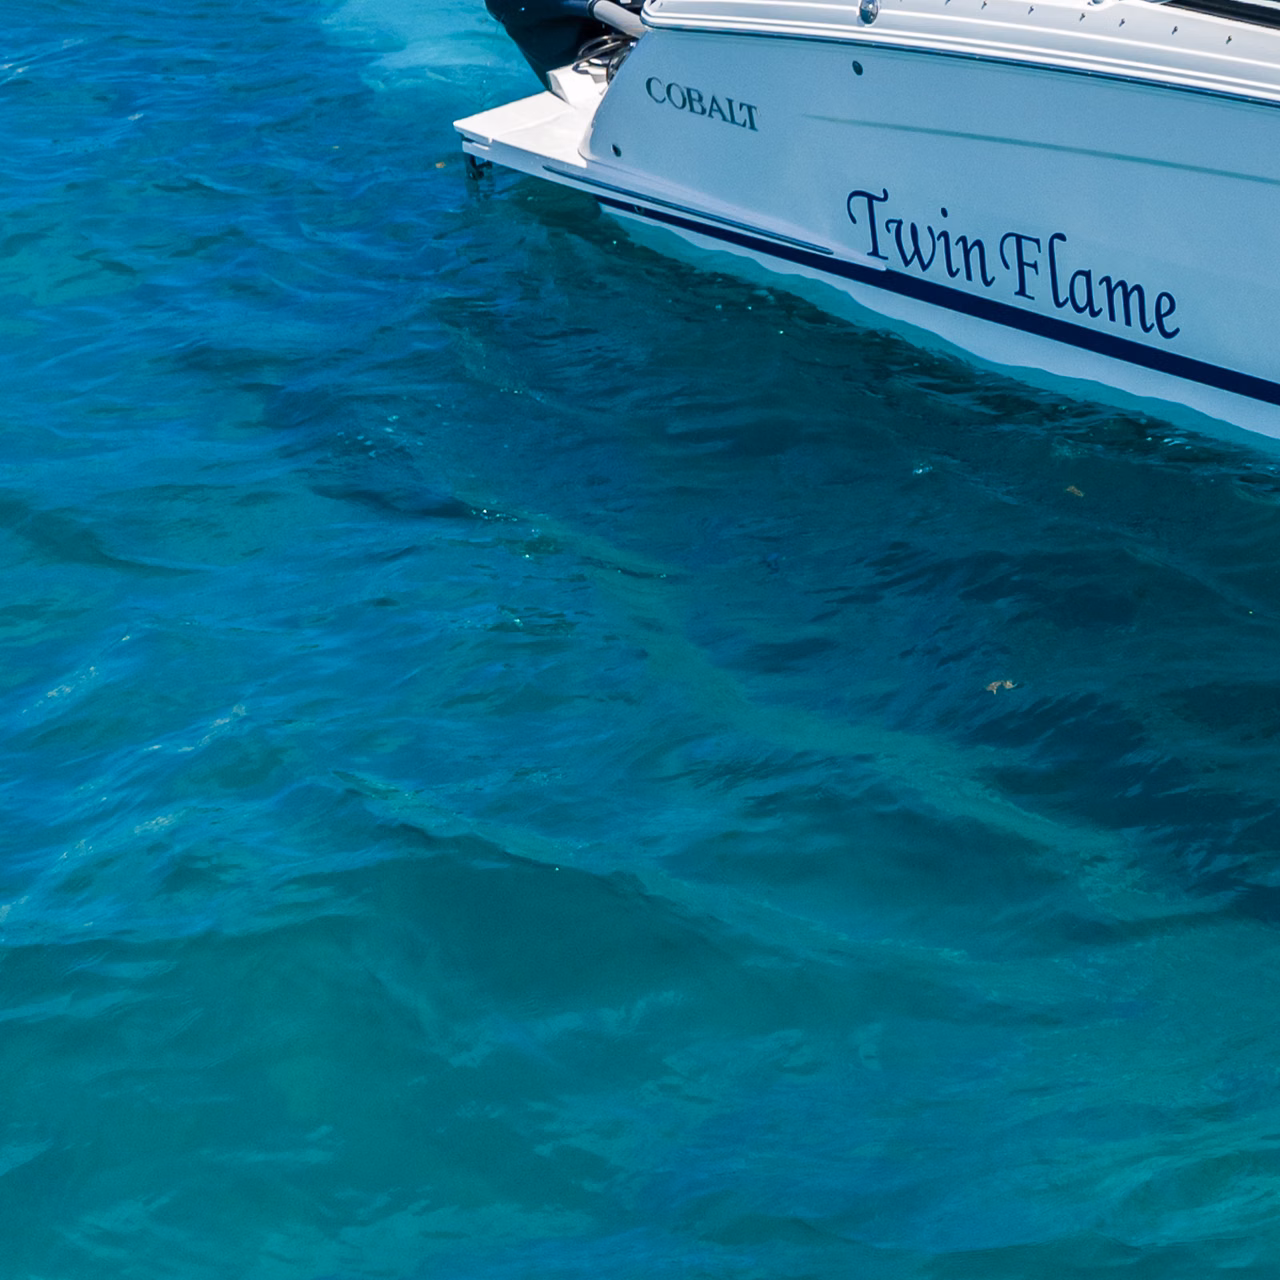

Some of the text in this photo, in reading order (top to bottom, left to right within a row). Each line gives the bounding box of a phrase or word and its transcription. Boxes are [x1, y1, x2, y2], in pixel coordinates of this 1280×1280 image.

[645, 76, 760, 132] COBALT
[847, 187, 1180, 340] Twin Flame
